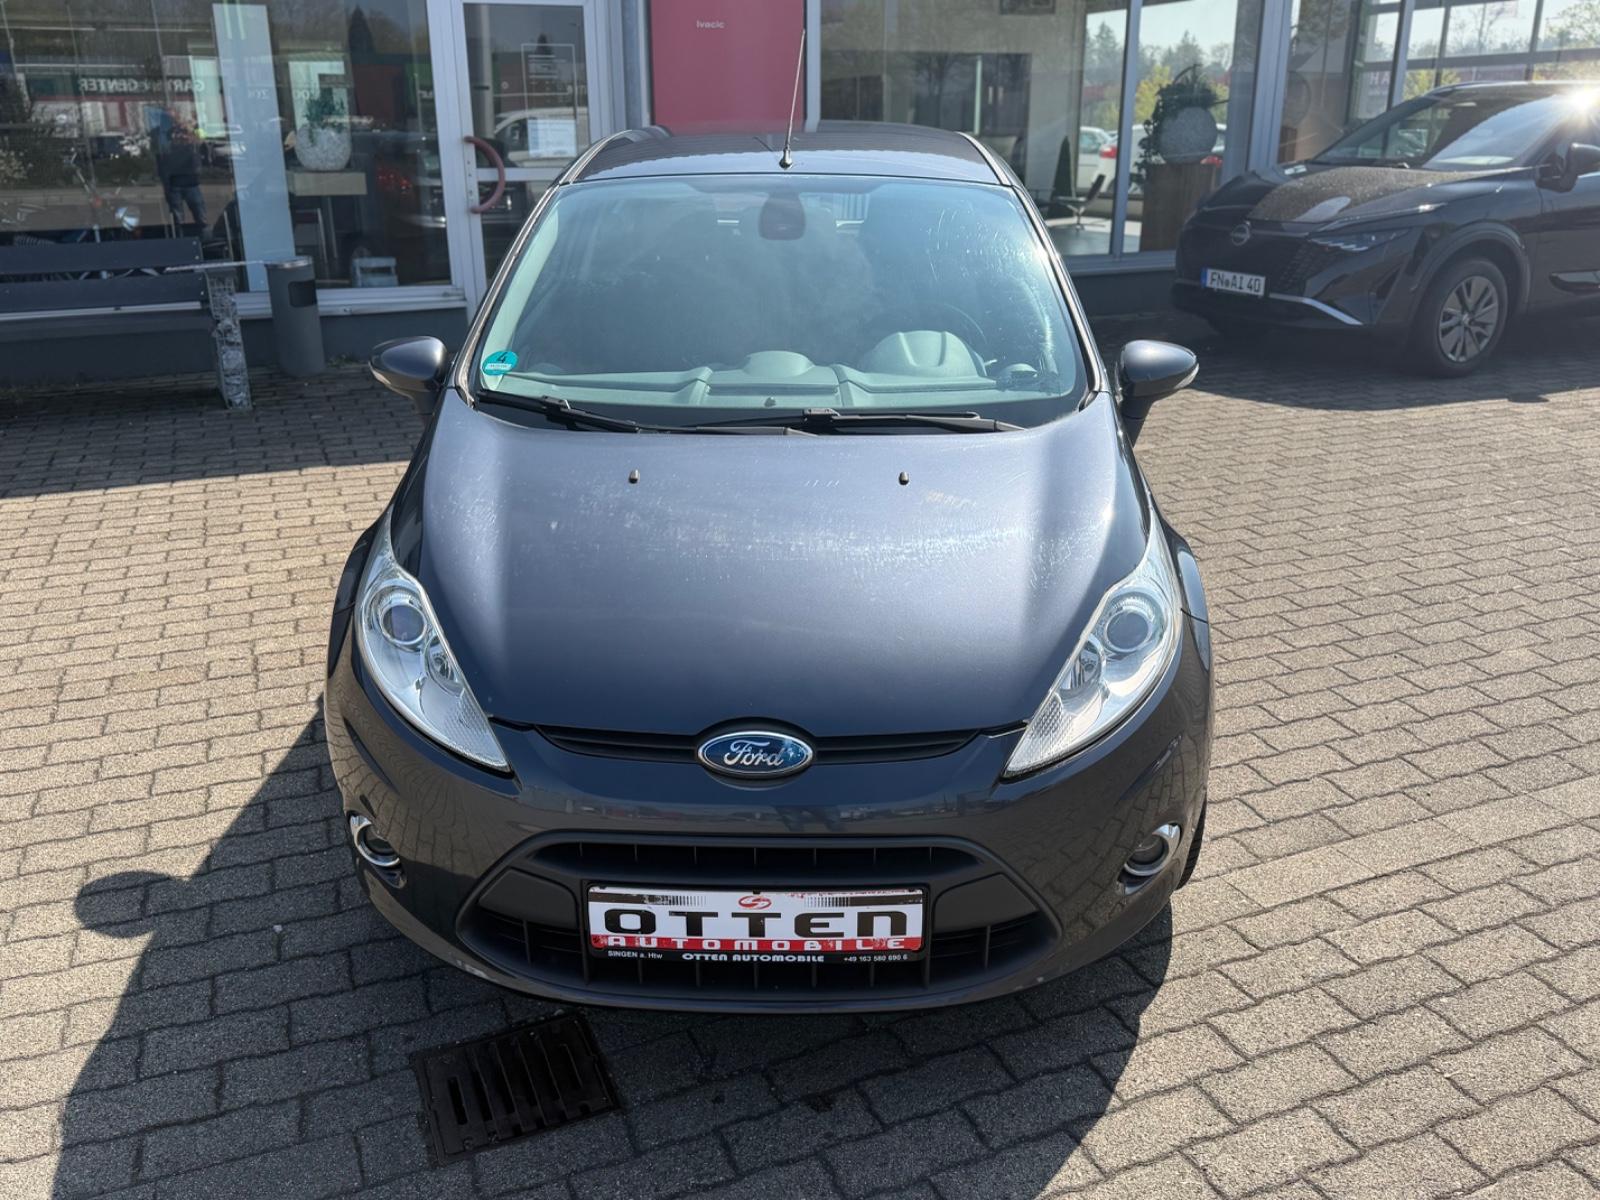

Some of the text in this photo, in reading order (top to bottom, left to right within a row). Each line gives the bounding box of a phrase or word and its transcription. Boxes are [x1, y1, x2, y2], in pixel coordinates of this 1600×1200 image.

[1210, 271, 1225, 287] FN
[496, 351, 507, 363] 4
[723, 739, 784, 766] Ford
[604, 908, 908, 938] OTTEN
[607, 936, 905, 951] AUTOMOBILE
[608, 950, 638, 958] SINGEN
[682, 952, 824, 963] OTTEN AUTOMOBILE
